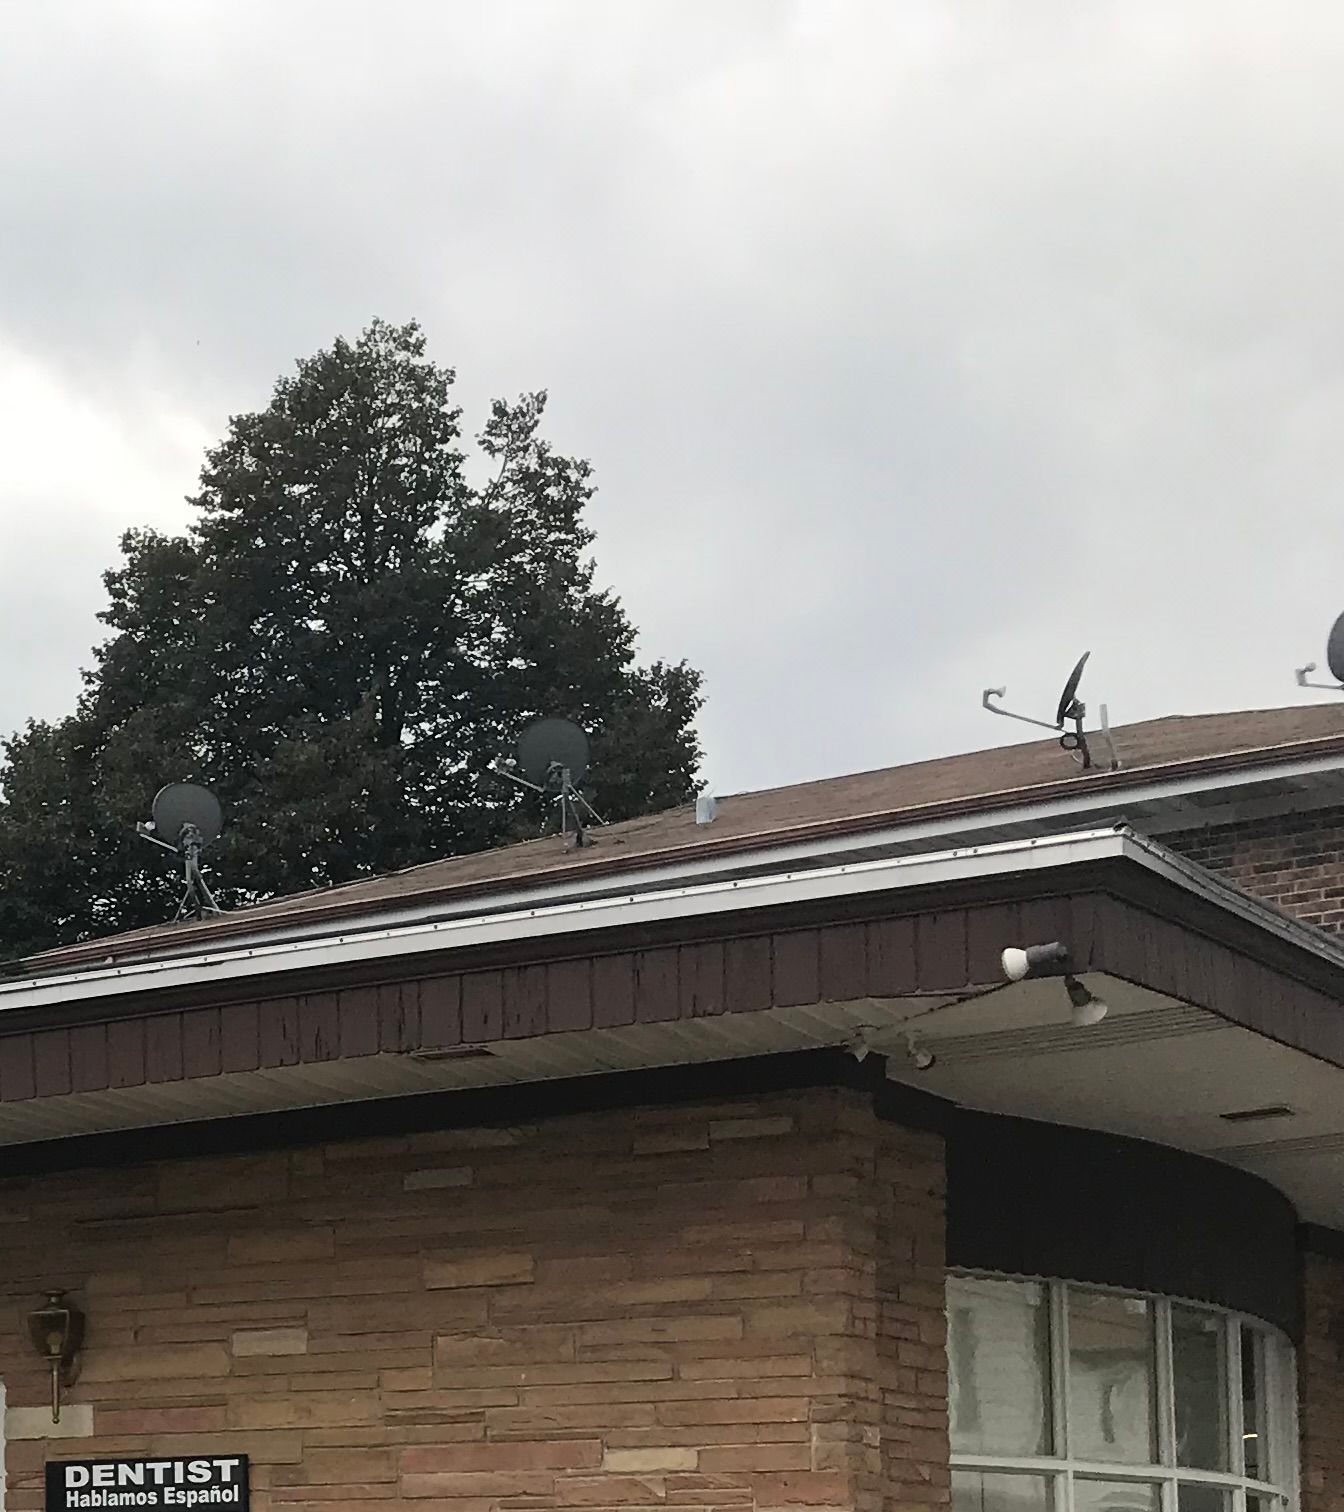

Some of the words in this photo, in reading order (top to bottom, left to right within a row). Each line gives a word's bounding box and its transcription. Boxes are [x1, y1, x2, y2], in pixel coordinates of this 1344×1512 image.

[65, 1459, 240, 1488] DENTIST
[66, 1489, 158, 1508] Hablamos
[164, 1485, 239, 1507] Español
